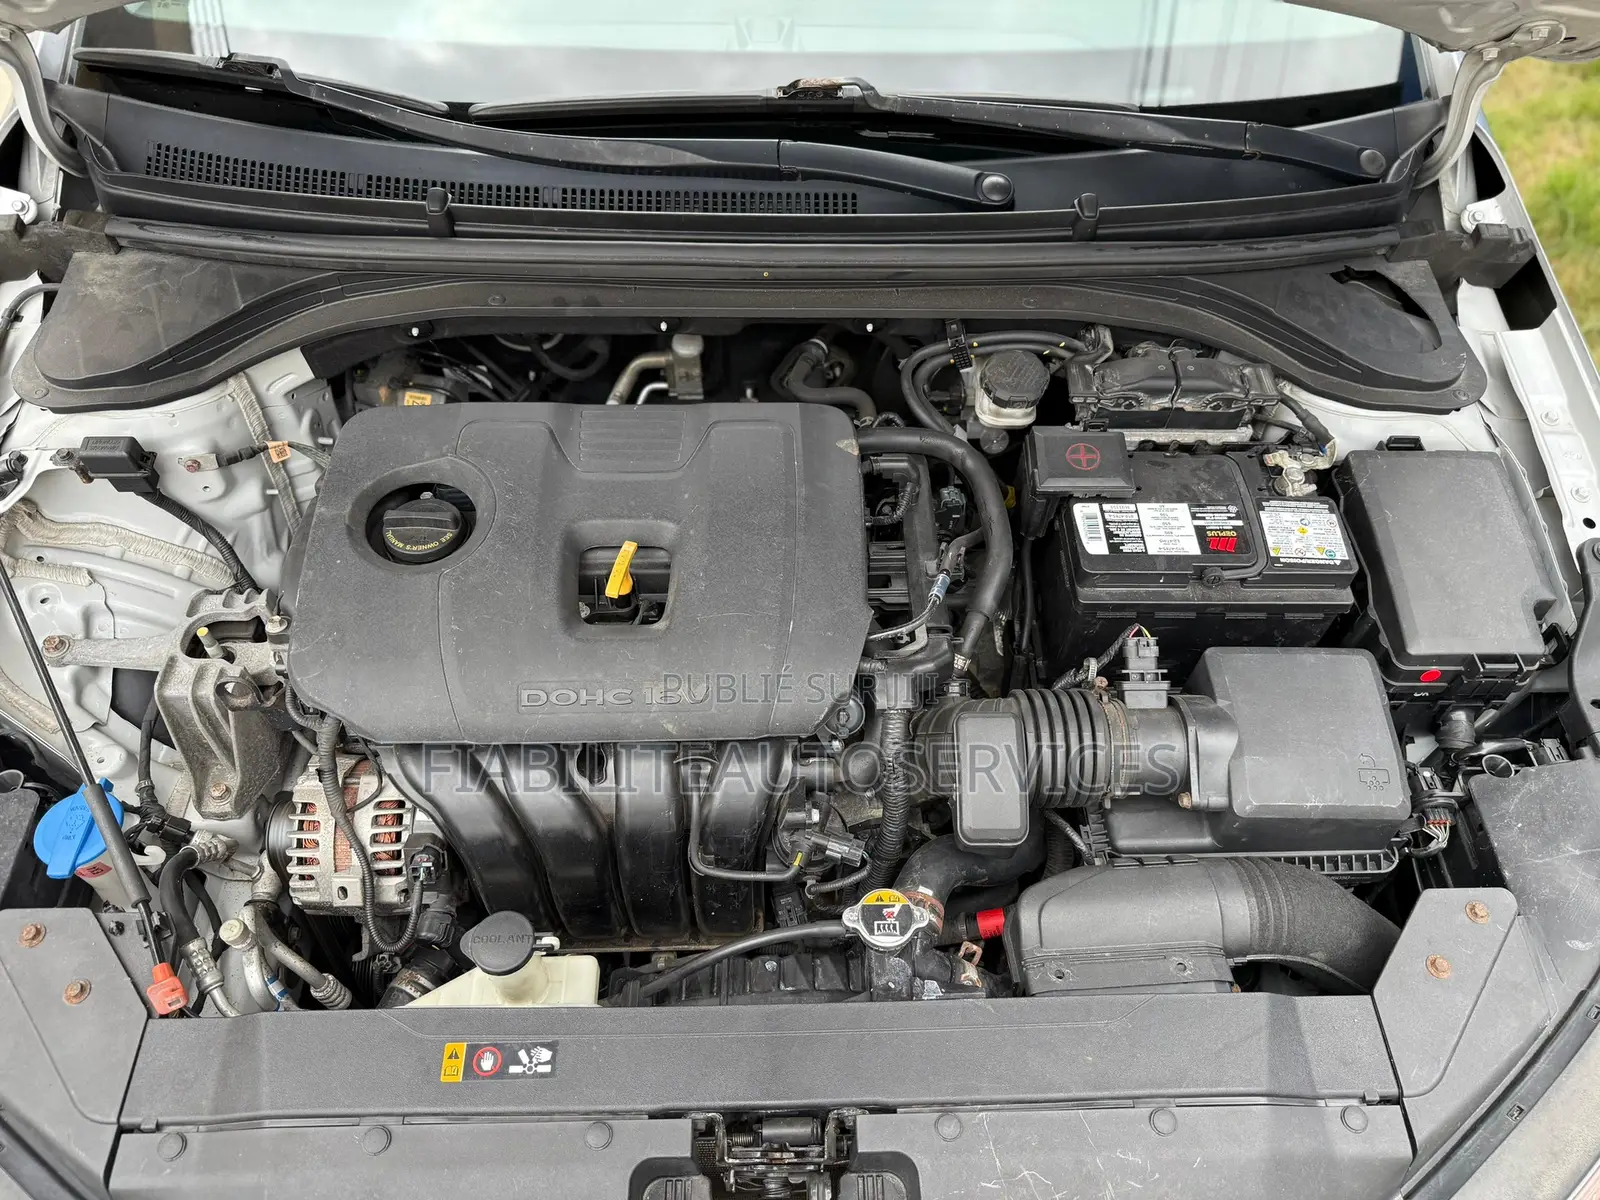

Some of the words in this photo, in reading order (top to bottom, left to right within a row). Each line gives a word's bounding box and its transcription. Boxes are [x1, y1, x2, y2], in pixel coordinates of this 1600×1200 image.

[385, 530, 404, 548] MANUAL
[440, 531, 453, 543] SEE
[406, 541, 439, 551] OWNER'S
[520, 687, 634, 707] DOHC
[642, 686, 711, 706] 16V
[473, 934, 533, 944] COOLANT
